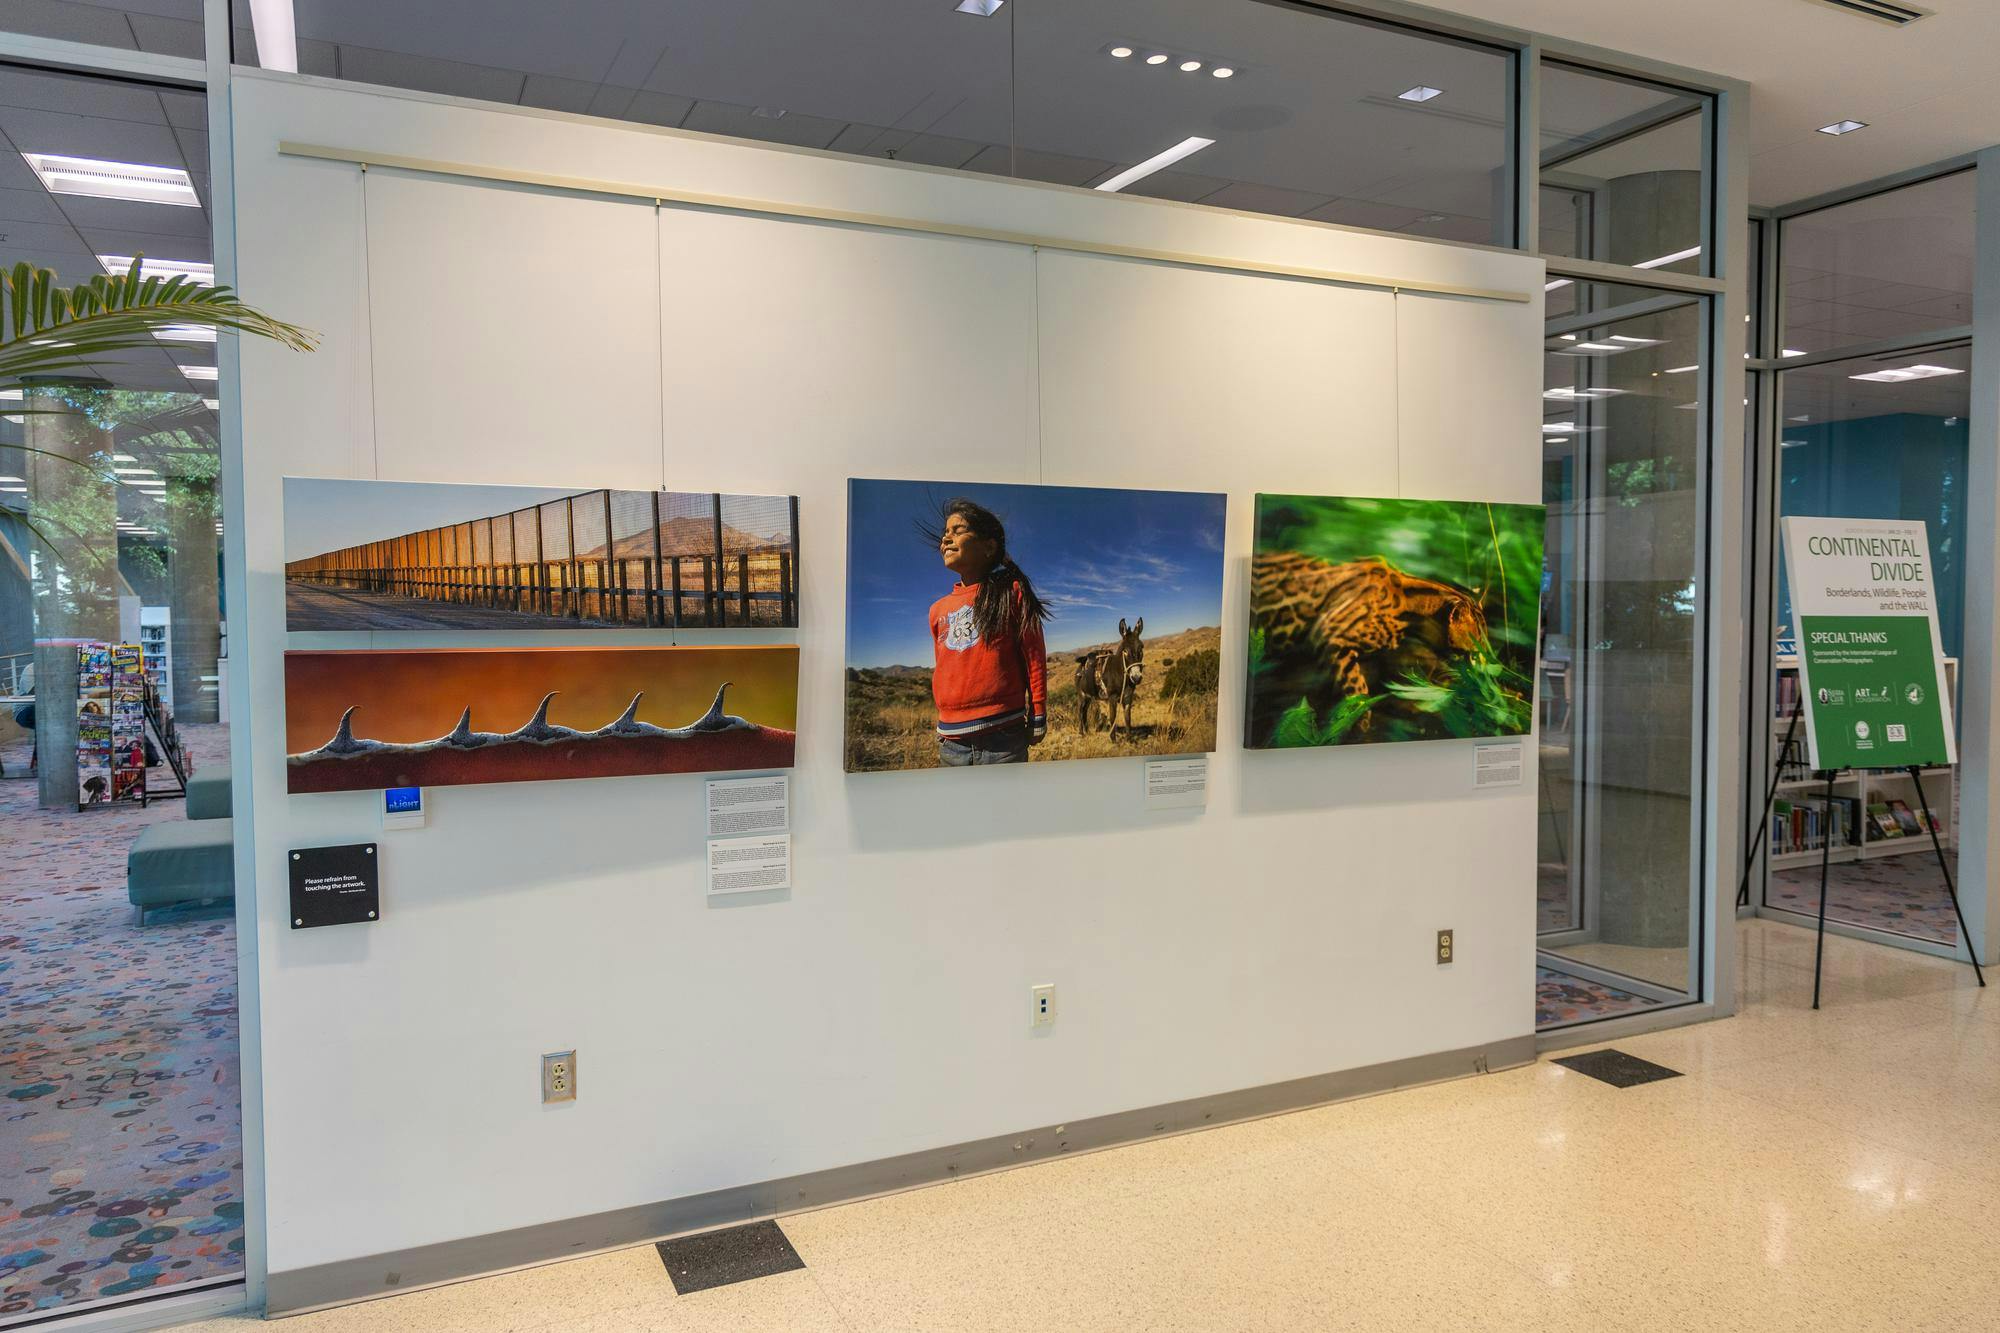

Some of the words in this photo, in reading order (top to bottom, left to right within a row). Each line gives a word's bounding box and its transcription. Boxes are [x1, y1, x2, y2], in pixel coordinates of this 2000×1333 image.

[1808, 536, 1921, 557] CONTINENTAL
[1870, 562, 1924, 581] DIVIDE
[1825, 587, 1871, 598] Borderlands,
[1872, 588, 1901, 598] Wildlife,
[1902, 589, 1927, 600] People
[1880, 601, 1893, 611] and
[1894, 601, 1907, 611] the
[1908, 602, 1928, 611] WALL
[1811, 632, 1849, 644] SPECIAL
[1849, 632, 1888, 644] THANKS
[1855, 688, 1870, 697] ART
[342, 880, 366, 888] artwork.
